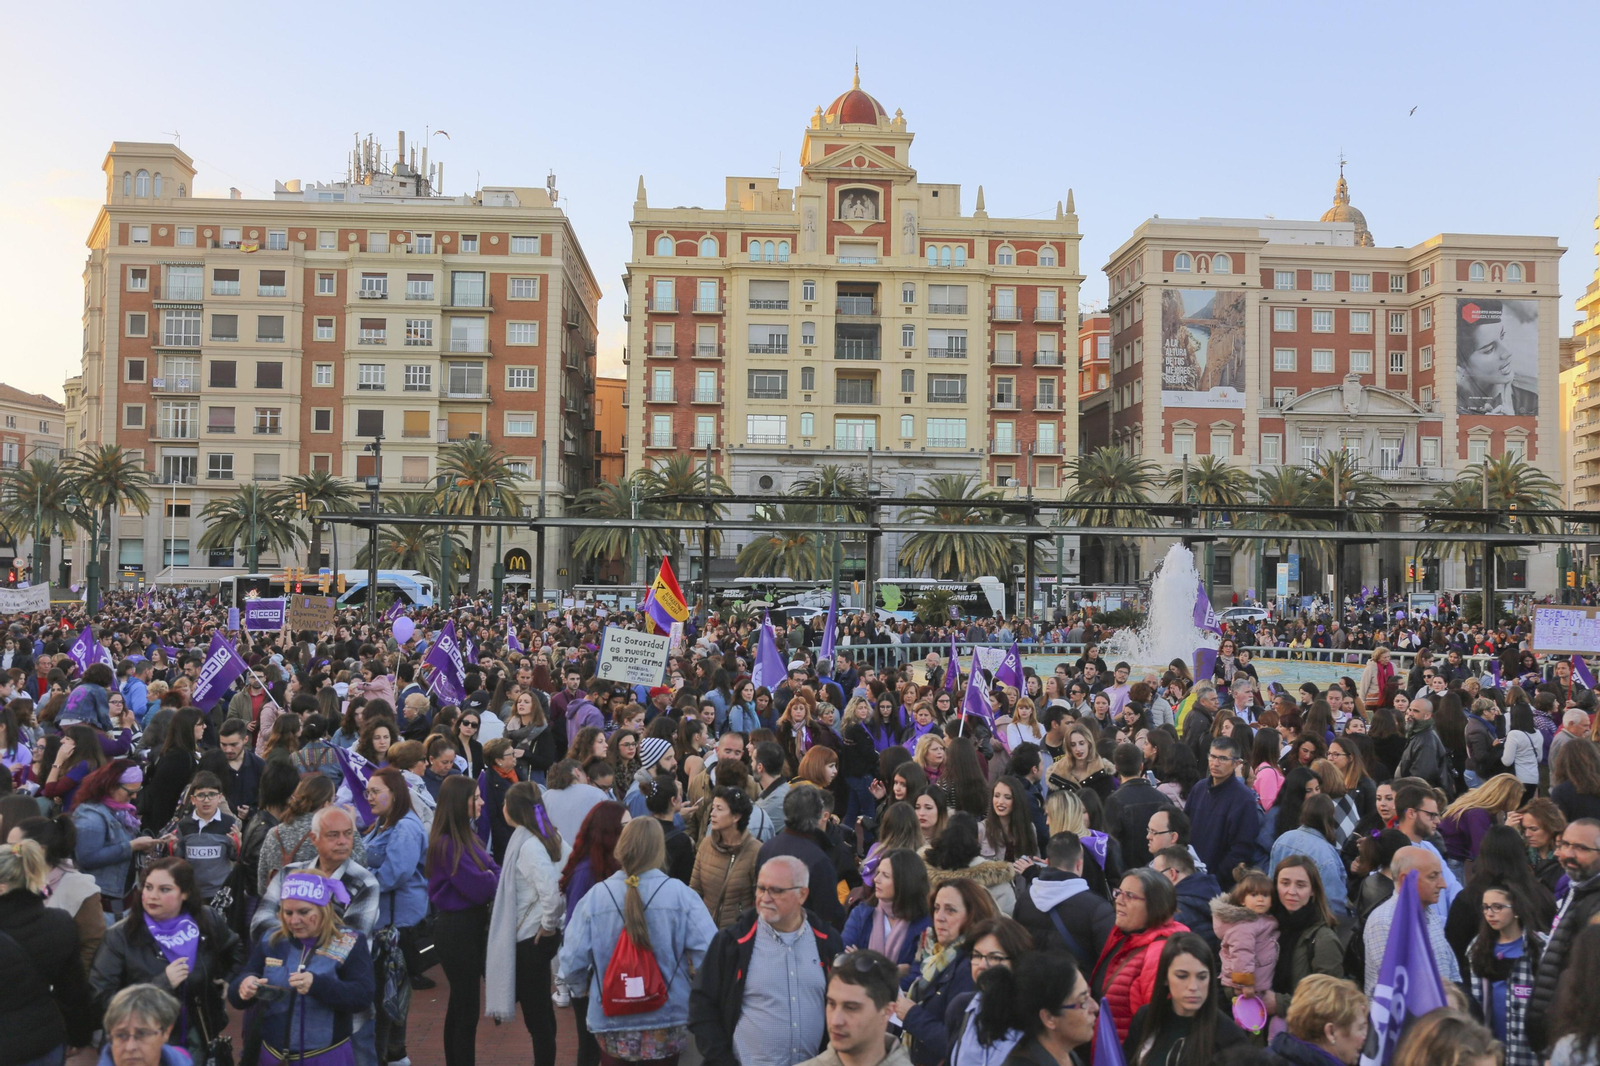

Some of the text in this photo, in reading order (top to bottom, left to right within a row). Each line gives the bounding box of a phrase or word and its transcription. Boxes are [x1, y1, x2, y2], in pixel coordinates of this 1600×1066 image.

[1165, 338, 1179, 347] A LA
[1165, 347, 1187, 356] ALTURA
[1165, 356, 1185, 366] DE TUS
[1165, 366, 1190, 374] MEJORES
[258, 610, 280, 618] CCOO
[1564, 618, 1576, 627] TU
[611, 635, 665, 650] La Sororidad
[624, 648, 656, 658] nuestra
[641, 659, 663, 667] arma
[187, 848, 220, 857] RUGBY
